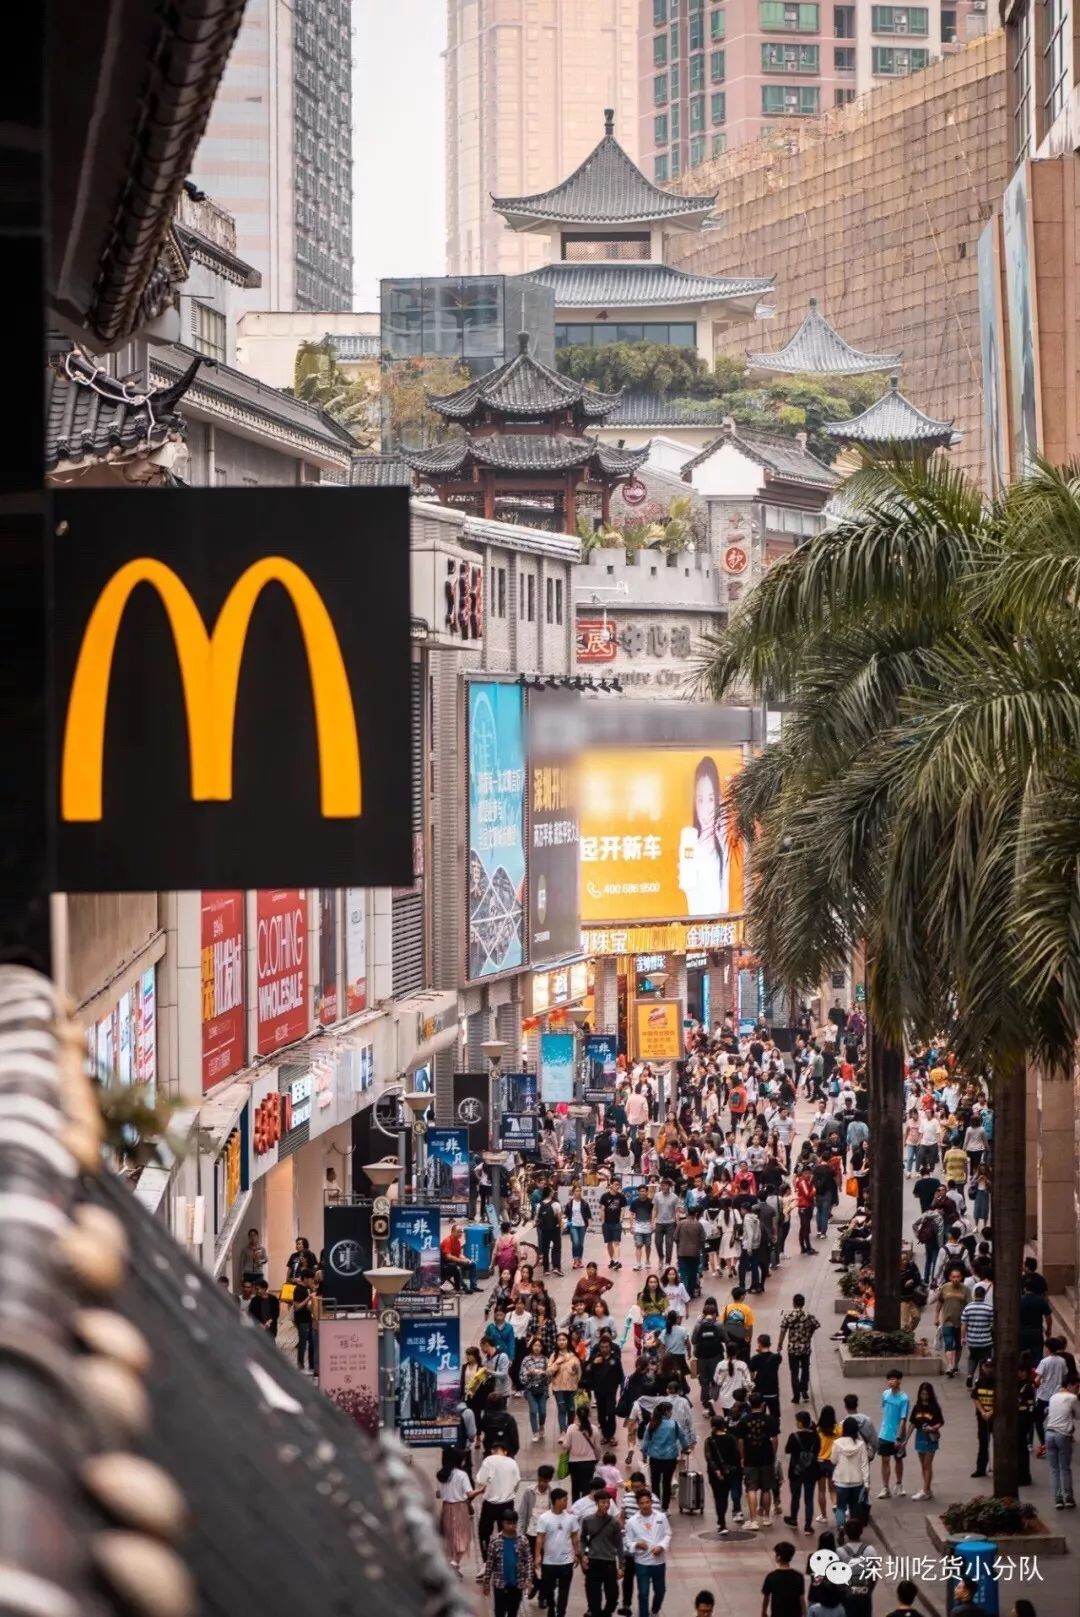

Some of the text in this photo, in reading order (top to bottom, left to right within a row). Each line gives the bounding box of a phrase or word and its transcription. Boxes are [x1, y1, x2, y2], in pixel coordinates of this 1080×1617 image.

[62, 556, 362, 822] M
[257, 908, 304, 979] CLOTHING
[257, 971, 304, 1023] WHOLESALE
